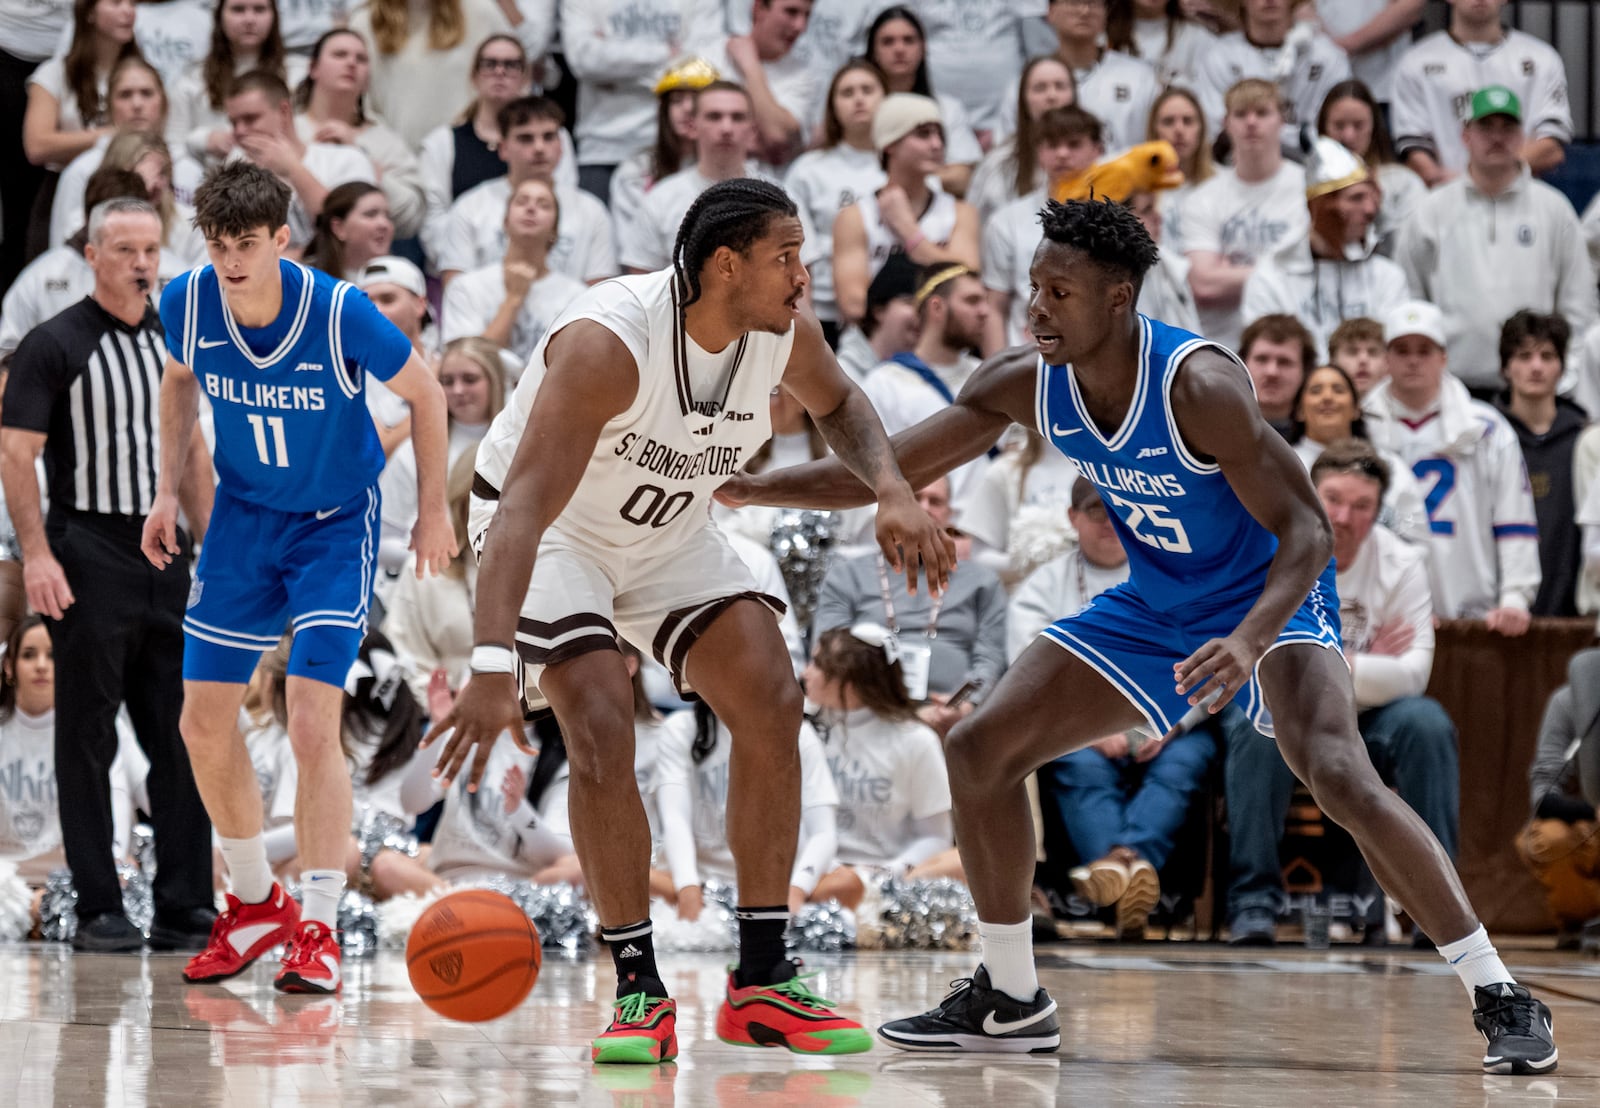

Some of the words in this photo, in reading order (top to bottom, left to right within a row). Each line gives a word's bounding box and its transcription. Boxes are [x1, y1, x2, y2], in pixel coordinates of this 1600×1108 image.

[205, 372, 326, 411] BILLIKENS
[721, 410, 754, 422] A10
[246, 413, 290, 468] 11
[1136, 446, 1169, 459] A10
[619, 483, 695, 529] 00
[1106, 491, 1193, 554] 25
[1276, 893, 1376, 917] HLEY
